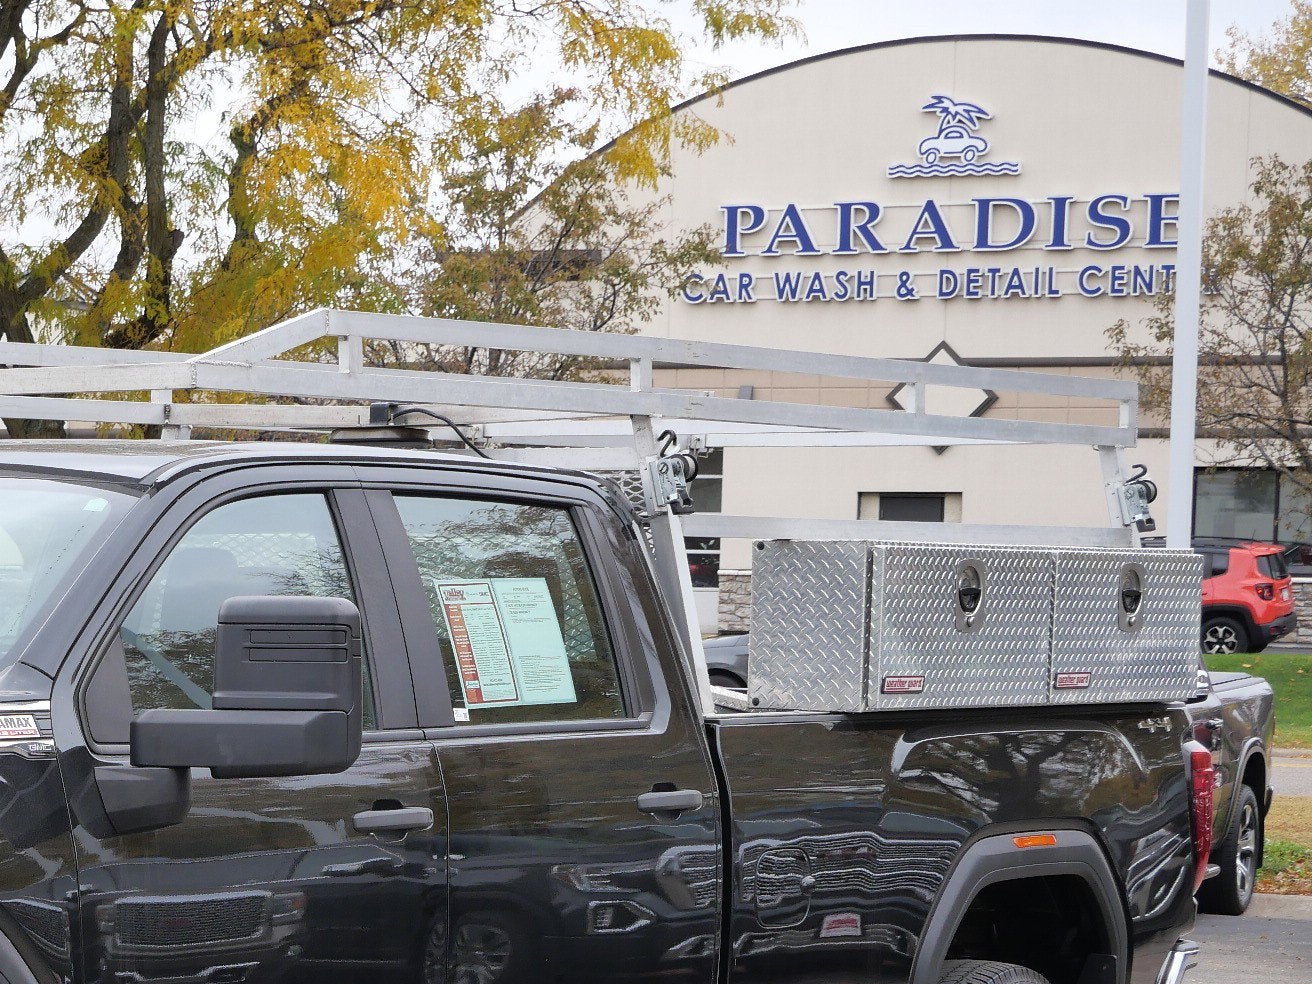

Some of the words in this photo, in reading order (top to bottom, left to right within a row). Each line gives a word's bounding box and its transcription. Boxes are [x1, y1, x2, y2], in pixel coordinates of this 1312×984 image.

[720, 194, 1179, 256] PARADISE
[685, 273, 755, 303] CAR
[774, 270, 875, 301] WASH
[896, 271, 918, 298] &
[937, 267, 1060, 298] DETAIL
[1078, 264, 1221, 297] CENT
